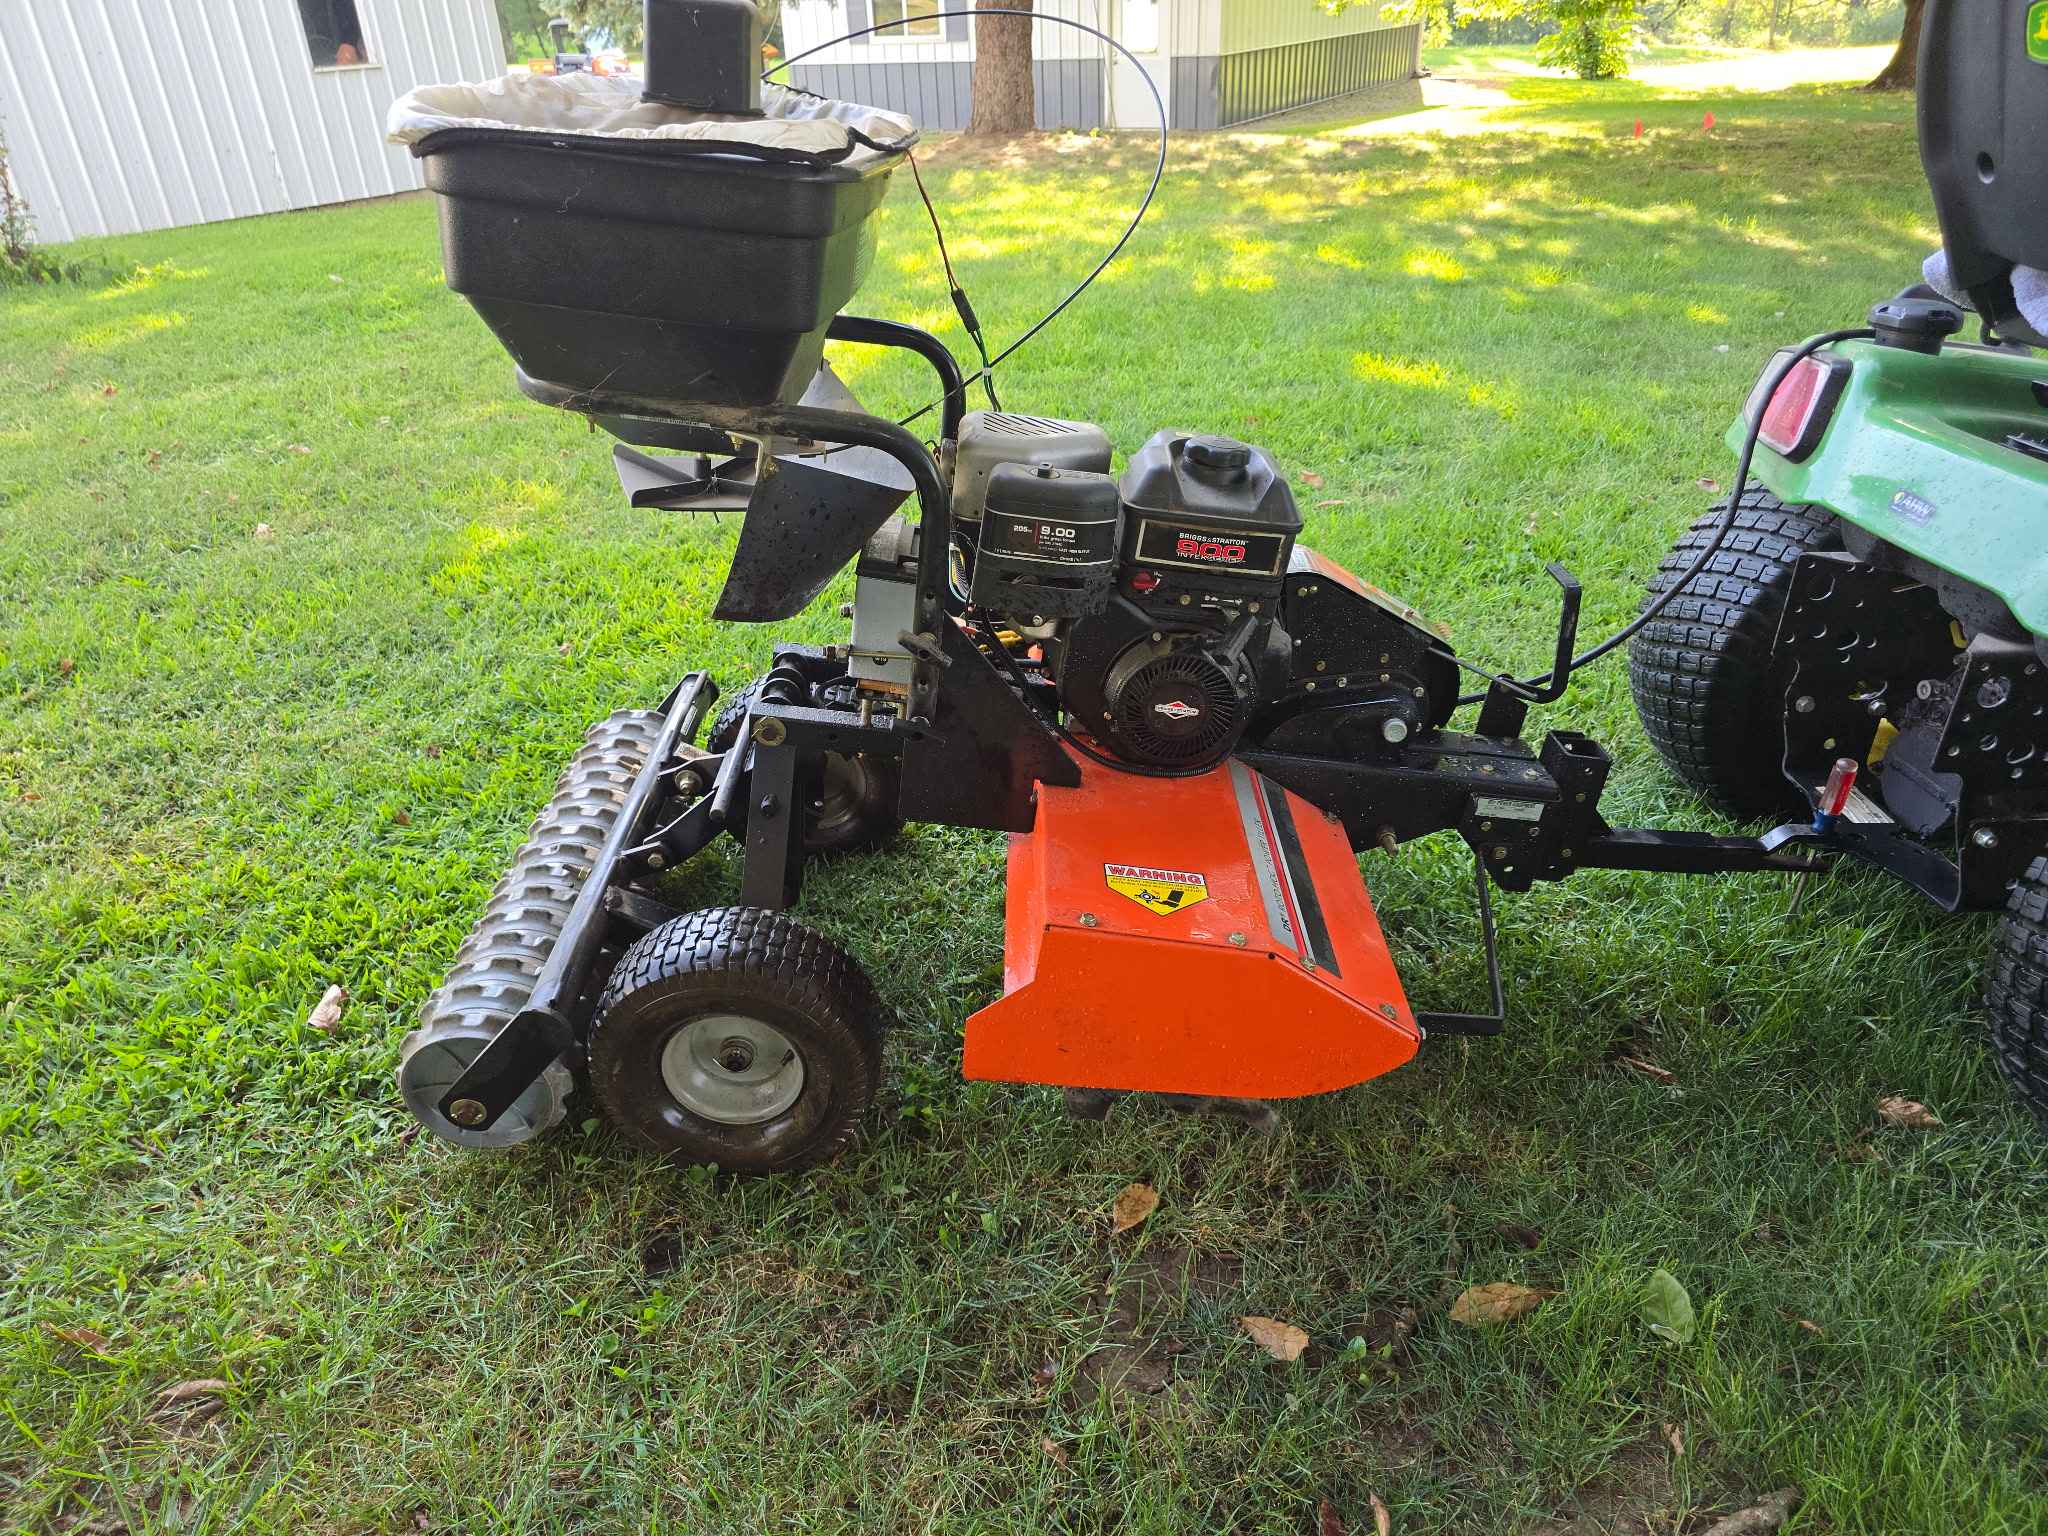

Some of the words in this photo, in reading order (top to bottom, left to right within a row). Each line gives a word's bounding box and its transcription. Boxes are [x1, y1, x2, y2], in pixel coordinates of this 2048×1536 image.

[1041, 526, 1075, 538] 9.00
[1177, 540, 1246, 561] 900
[1108, 865, 1202, 884] WARNING
